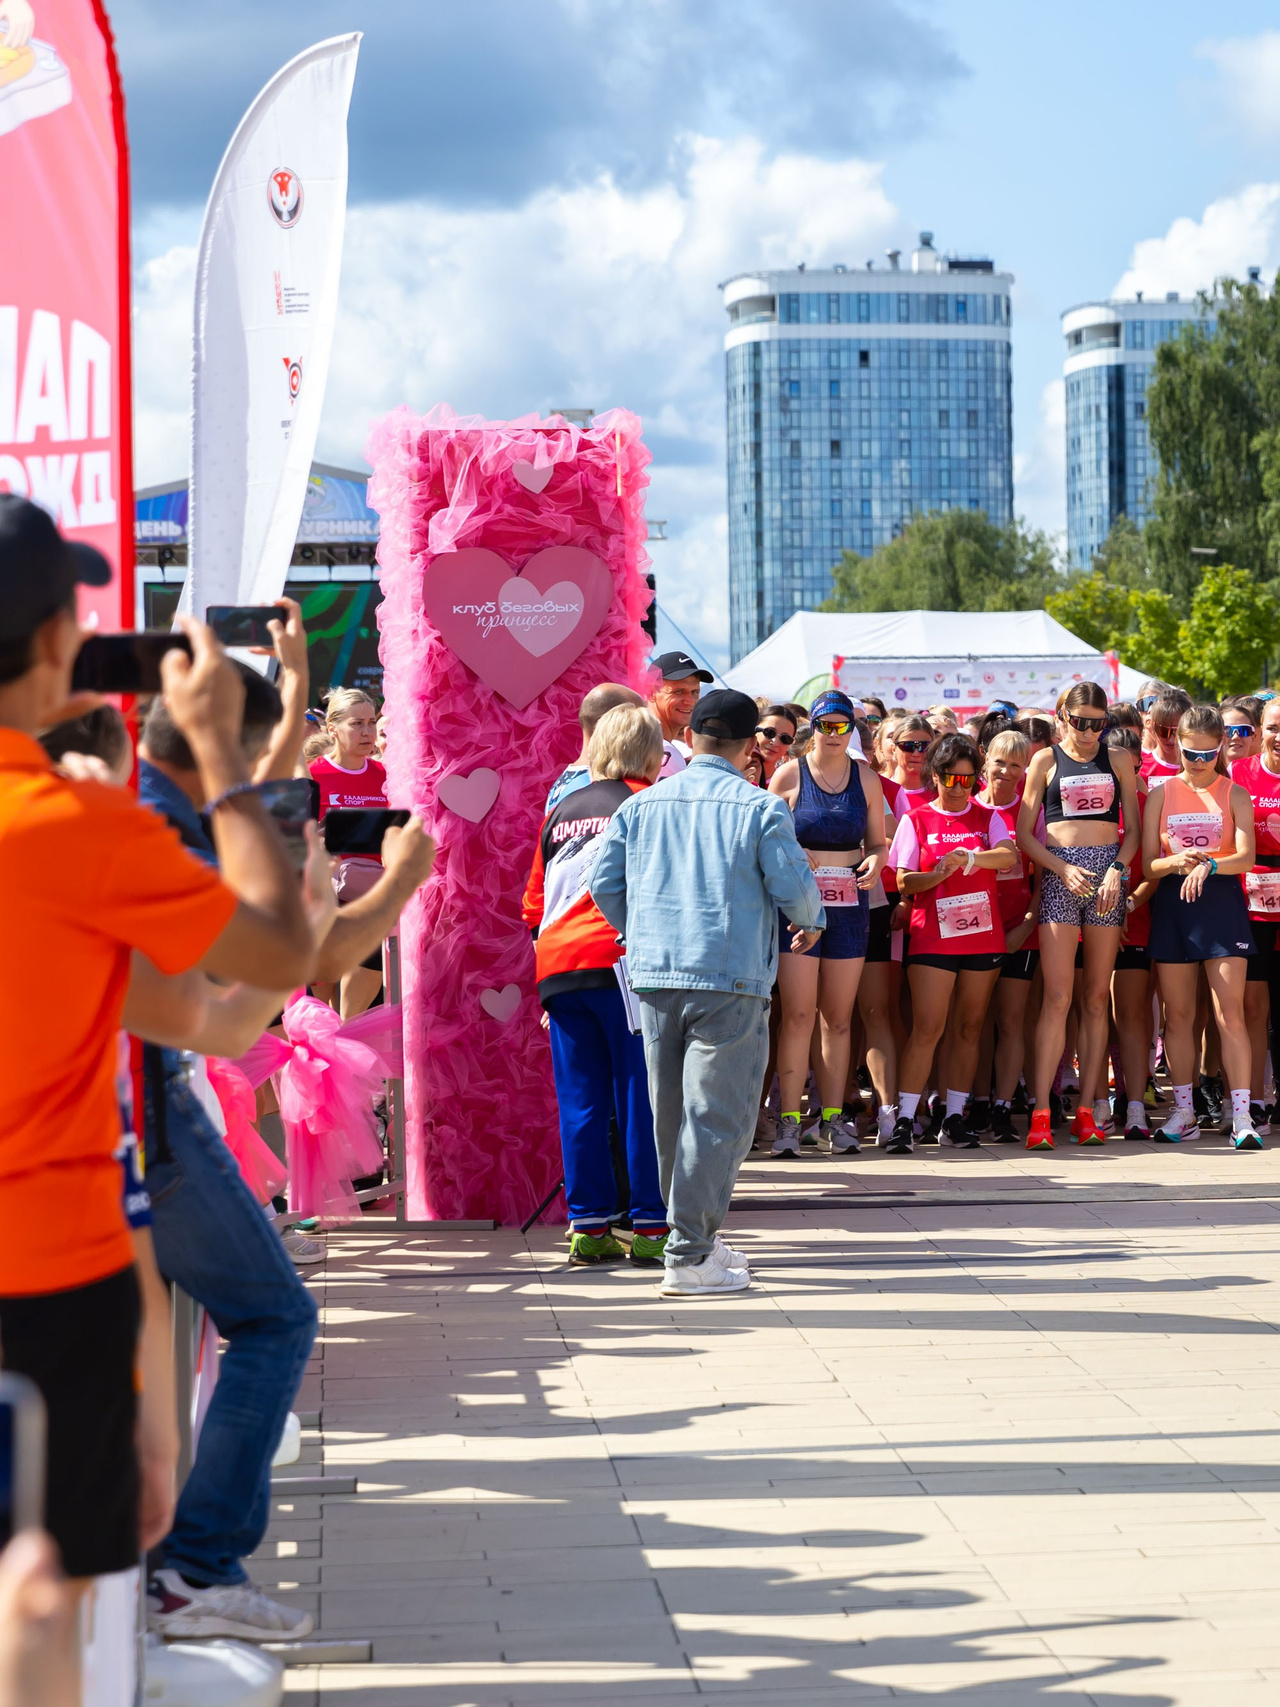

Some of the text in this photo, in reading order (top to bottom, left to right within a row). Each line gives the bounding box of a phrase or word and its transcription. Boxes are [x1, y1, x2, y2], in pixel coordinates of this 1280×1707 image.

[453, 600, 581, 616] клуб беговых
[476, 614, 558, 638] принцесс
[1077, 797, 1104, 811] 28
[1182, 835, 1209, 848] 30
[955, 915, 980, 931] 34
